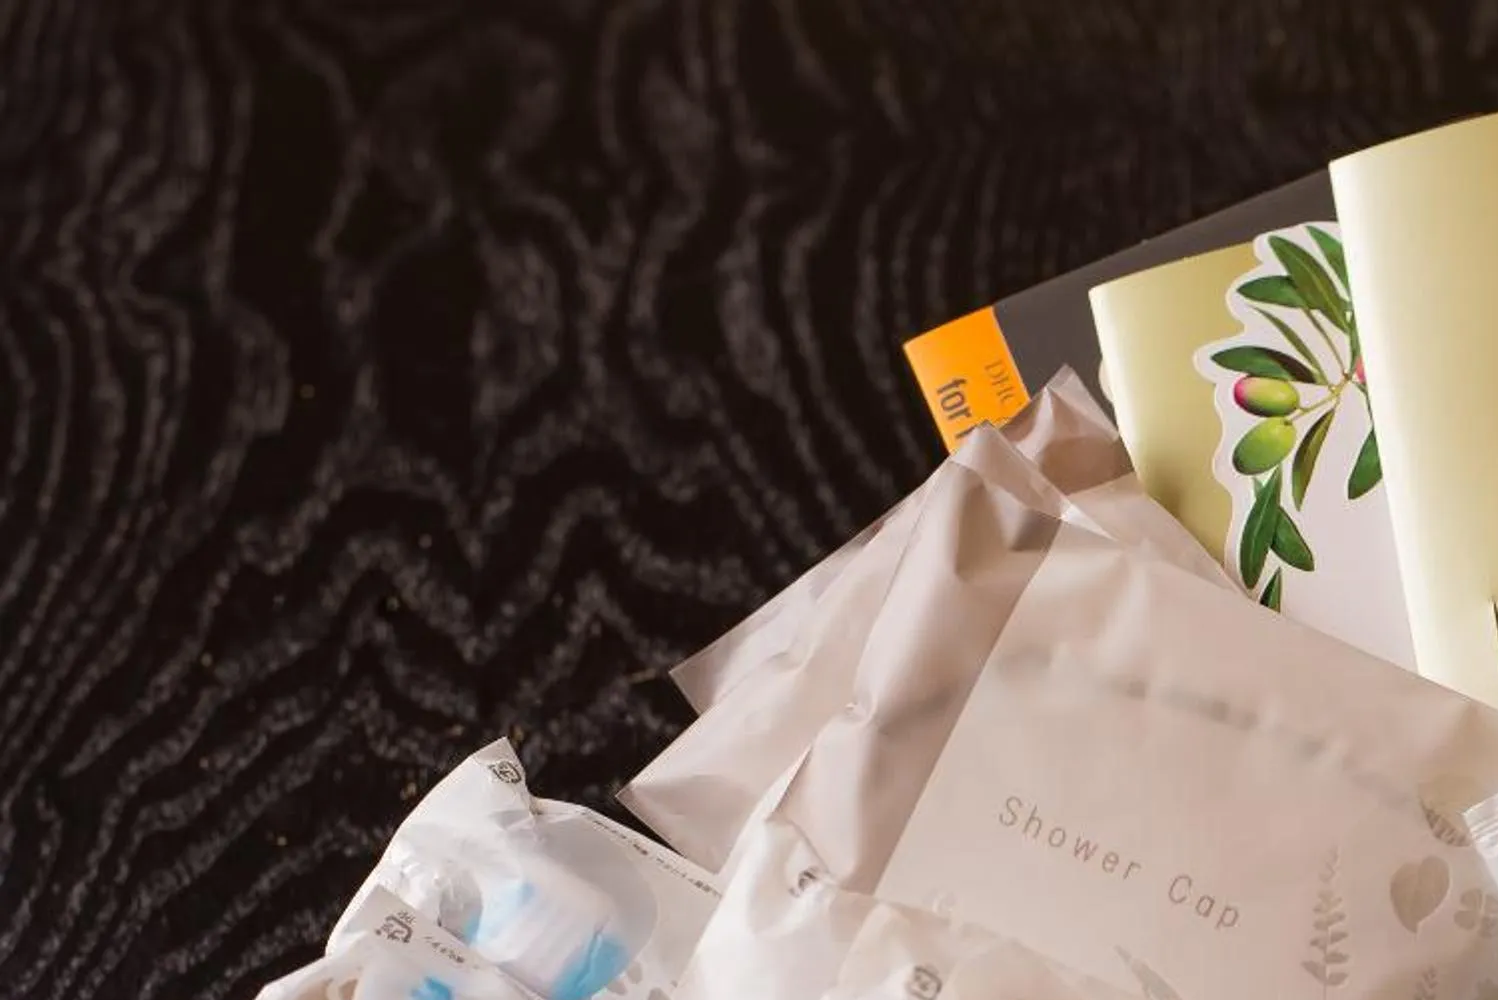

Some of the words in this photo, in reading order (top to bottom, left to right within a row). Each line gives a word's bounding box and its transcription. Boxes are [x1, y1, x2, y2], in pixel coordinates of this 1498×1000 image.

[936, 378, 972, 420] for
[998, 796, 1142, 881] Shower
[1167, 874, 1240, 930] Cap
